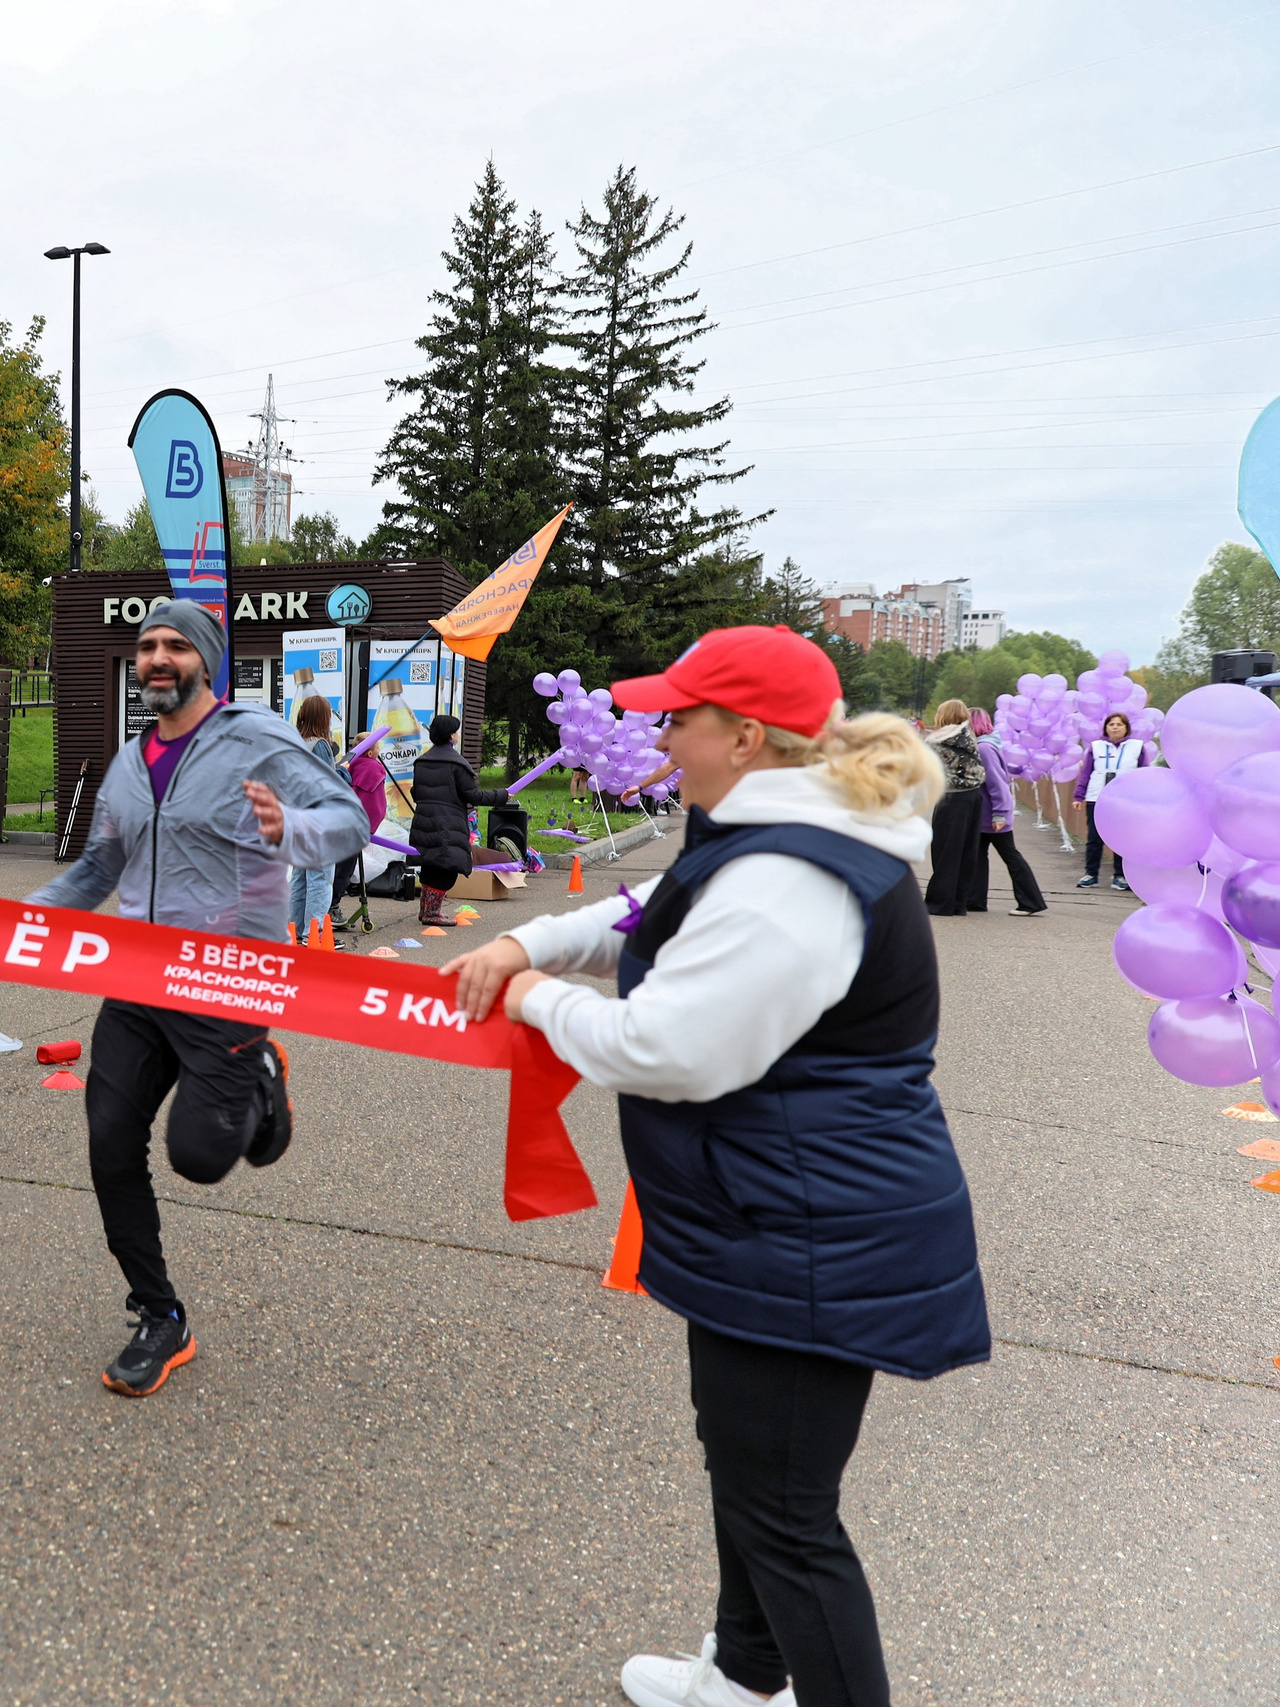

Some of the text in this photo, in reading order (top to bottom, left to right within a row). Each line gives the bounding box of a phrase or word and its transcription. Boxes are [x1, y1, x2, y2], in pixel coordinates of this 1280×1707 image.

[234, 591, 310, 621] ARK
[380, 749, 417, 760] БОЧКАРИ
[179, 940, 295, 978] 5 ВЁРСТ
[164, 964, 299, 999] КРАСНОЯРСК
[166, 982, 285, 1015] НАБЕРЕЖНАЯ
[359, 986, 389, 1016] 5
